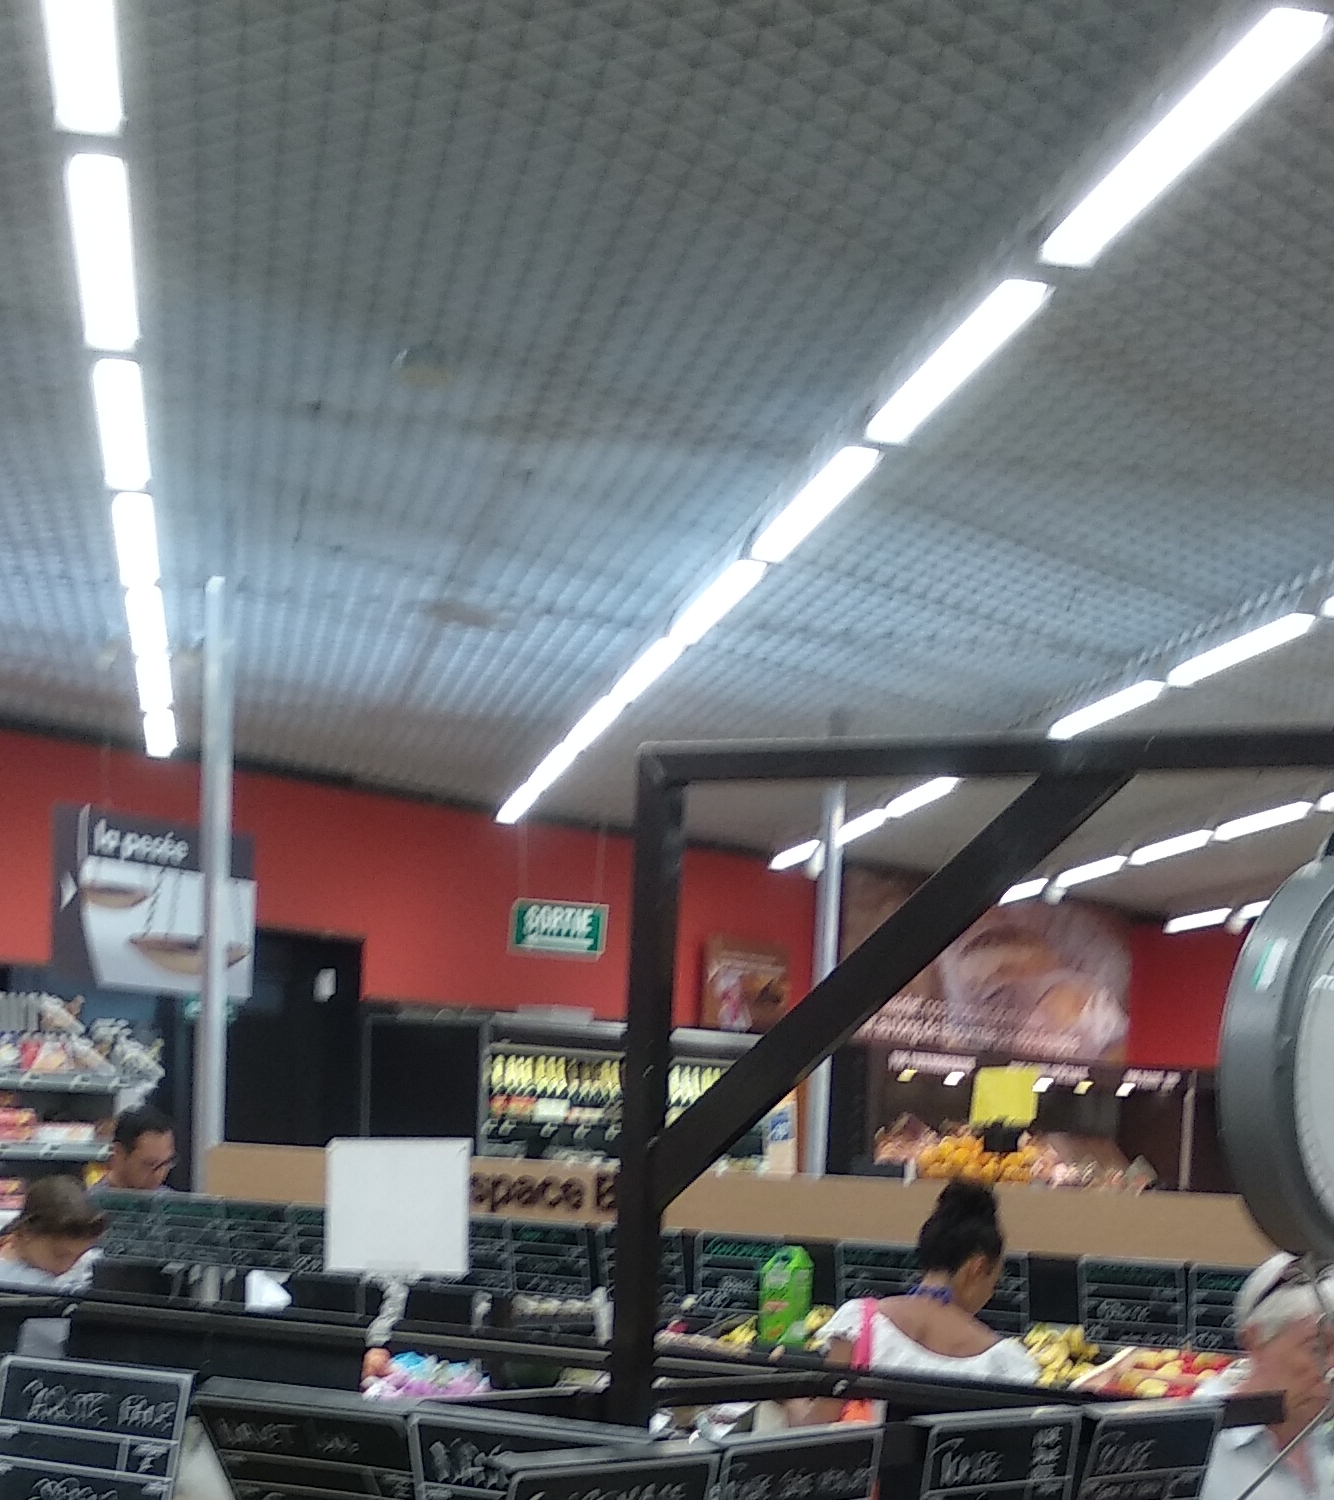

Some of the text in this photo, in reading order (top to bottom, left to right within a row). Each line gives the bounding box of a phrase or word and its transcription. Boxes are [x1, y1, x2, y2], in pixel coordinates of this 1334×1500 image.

[93, 817, 189, 866] la pesée
[522, 904, 594, 938] SORTIE
